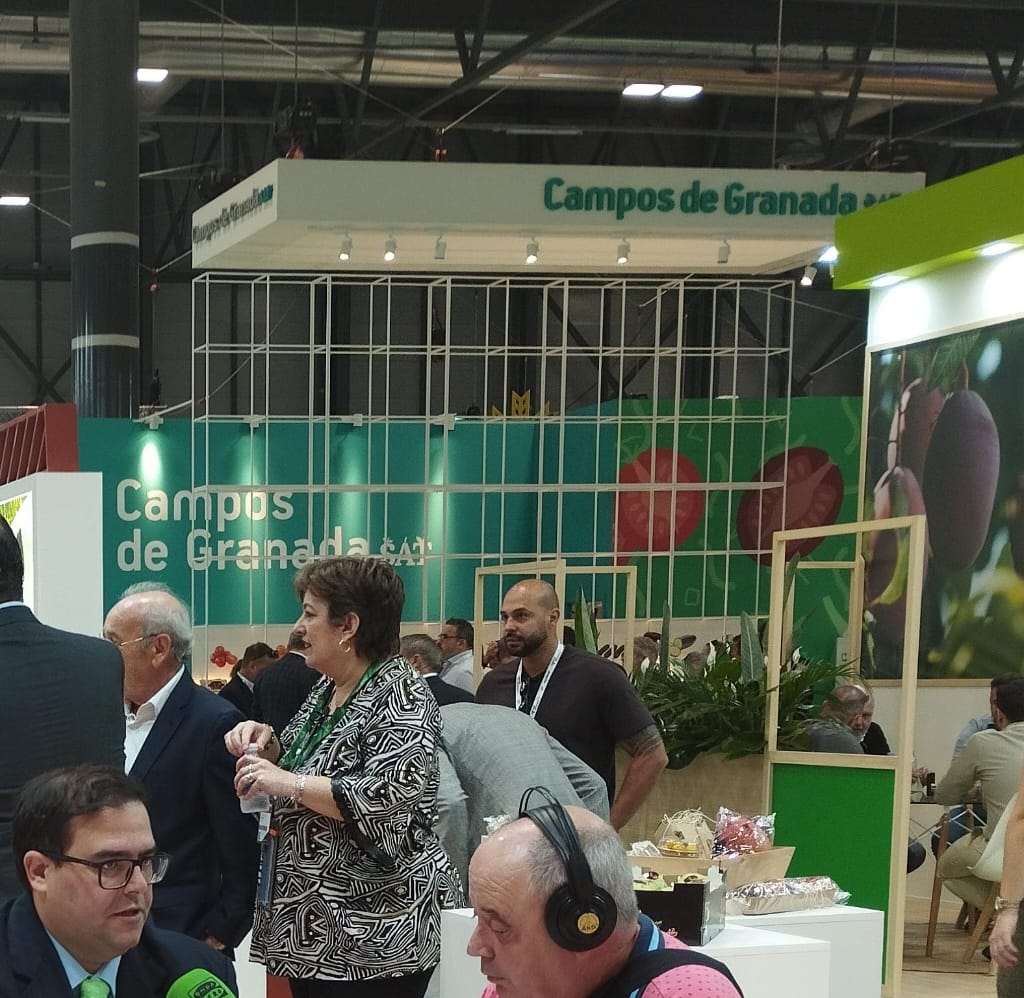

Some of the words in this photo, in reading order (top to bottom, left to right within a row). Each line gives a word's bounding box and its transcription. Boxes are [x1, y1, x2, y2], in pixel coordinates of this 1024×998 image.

[544, 177, 674, 219] Campos
[680, 180, 718, 213] de
[724, 182, 857, 216] Granada
[117, 479, 294, 532] Campos
[117, 529, 168, 571] de
[186, 526, 370, 571] Granada
